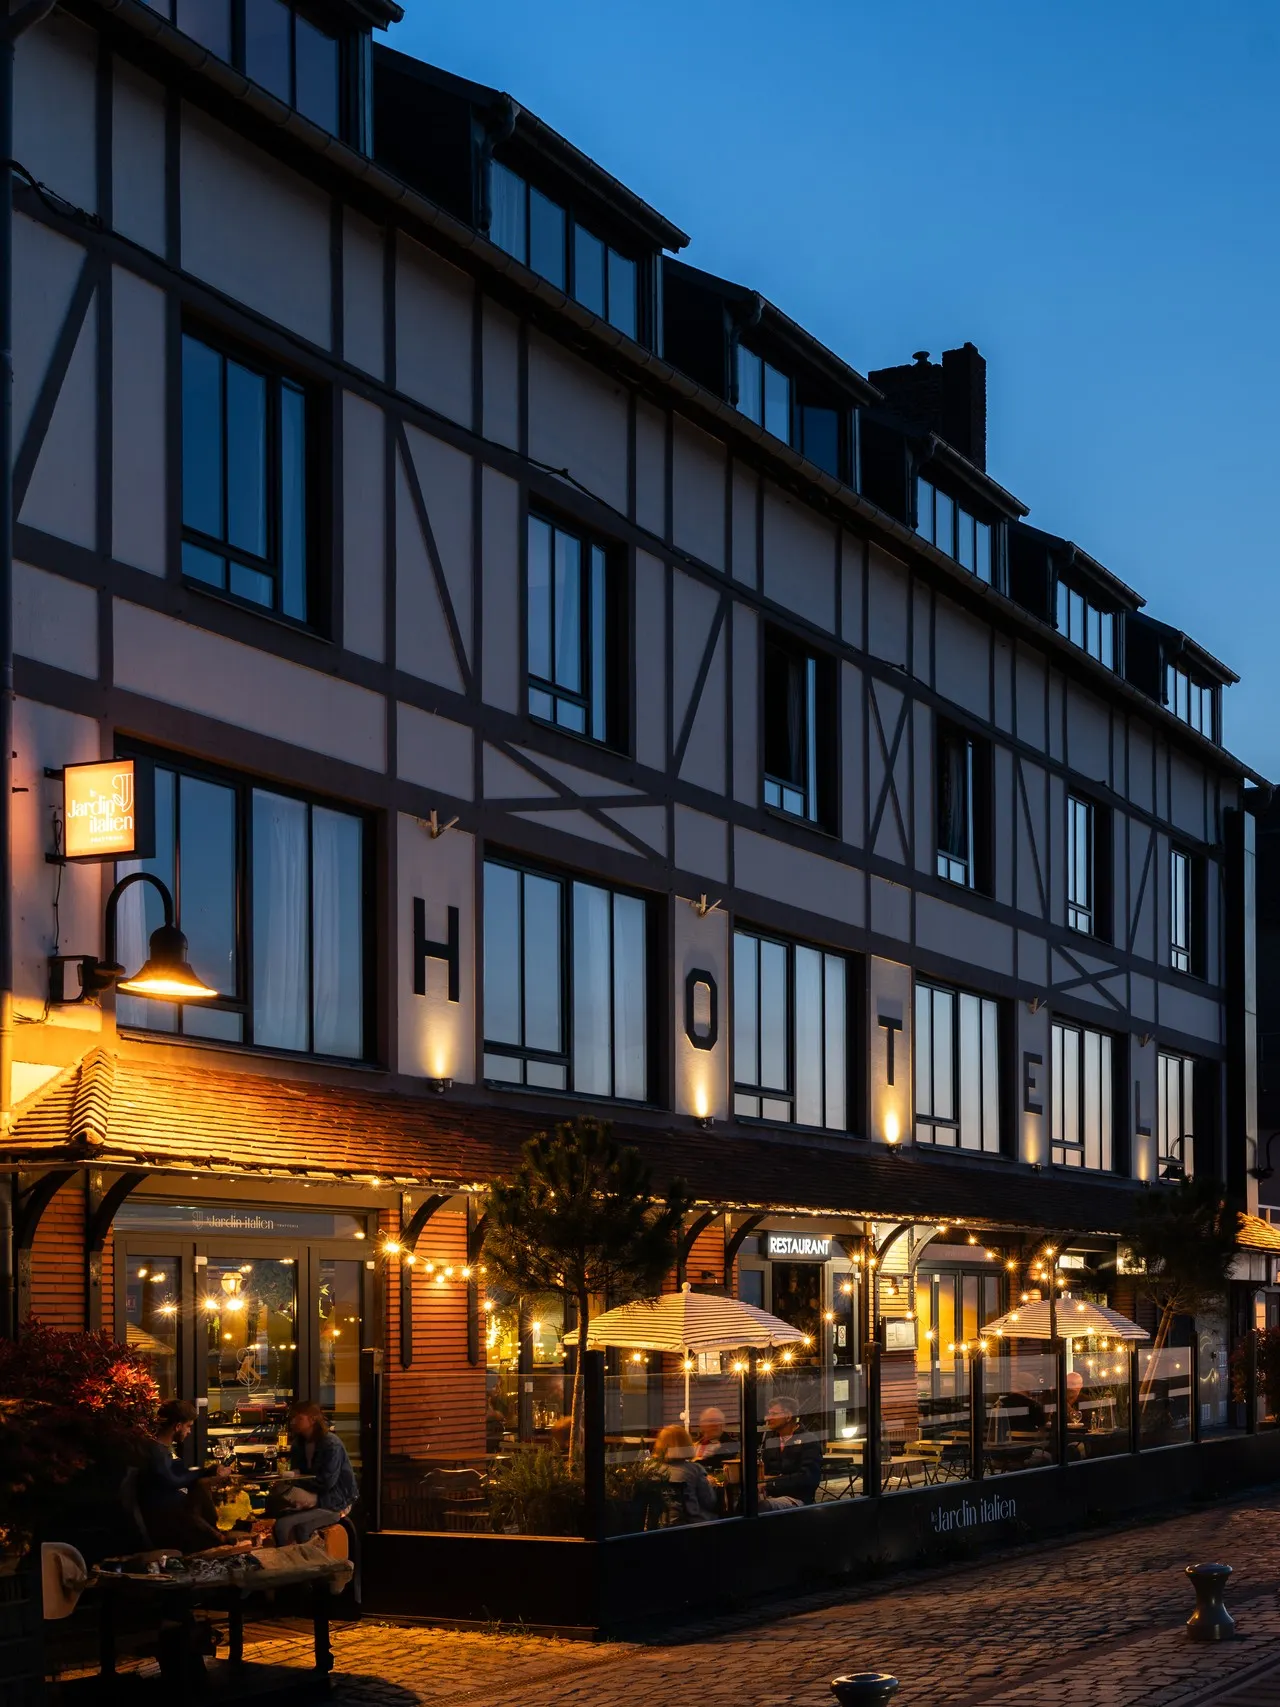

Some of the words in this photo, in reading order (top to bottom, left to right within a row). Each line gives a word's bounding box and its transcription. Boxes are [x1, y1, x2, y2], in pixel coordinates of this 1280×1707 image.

[67, 795, 115, 818] Jardin
[89, 814, 133, 834] italien
[413, 896, 1151, 1137] HOTEL
[208, 1215, 241, 1229] Jardin
[244, 1215, 274, 1230] italien
[770, 1237, 830, 1255] RESTAURANT
[934, 1500, 977, 1533] Jardin
[980, 1494, 1016, 1523] italien
